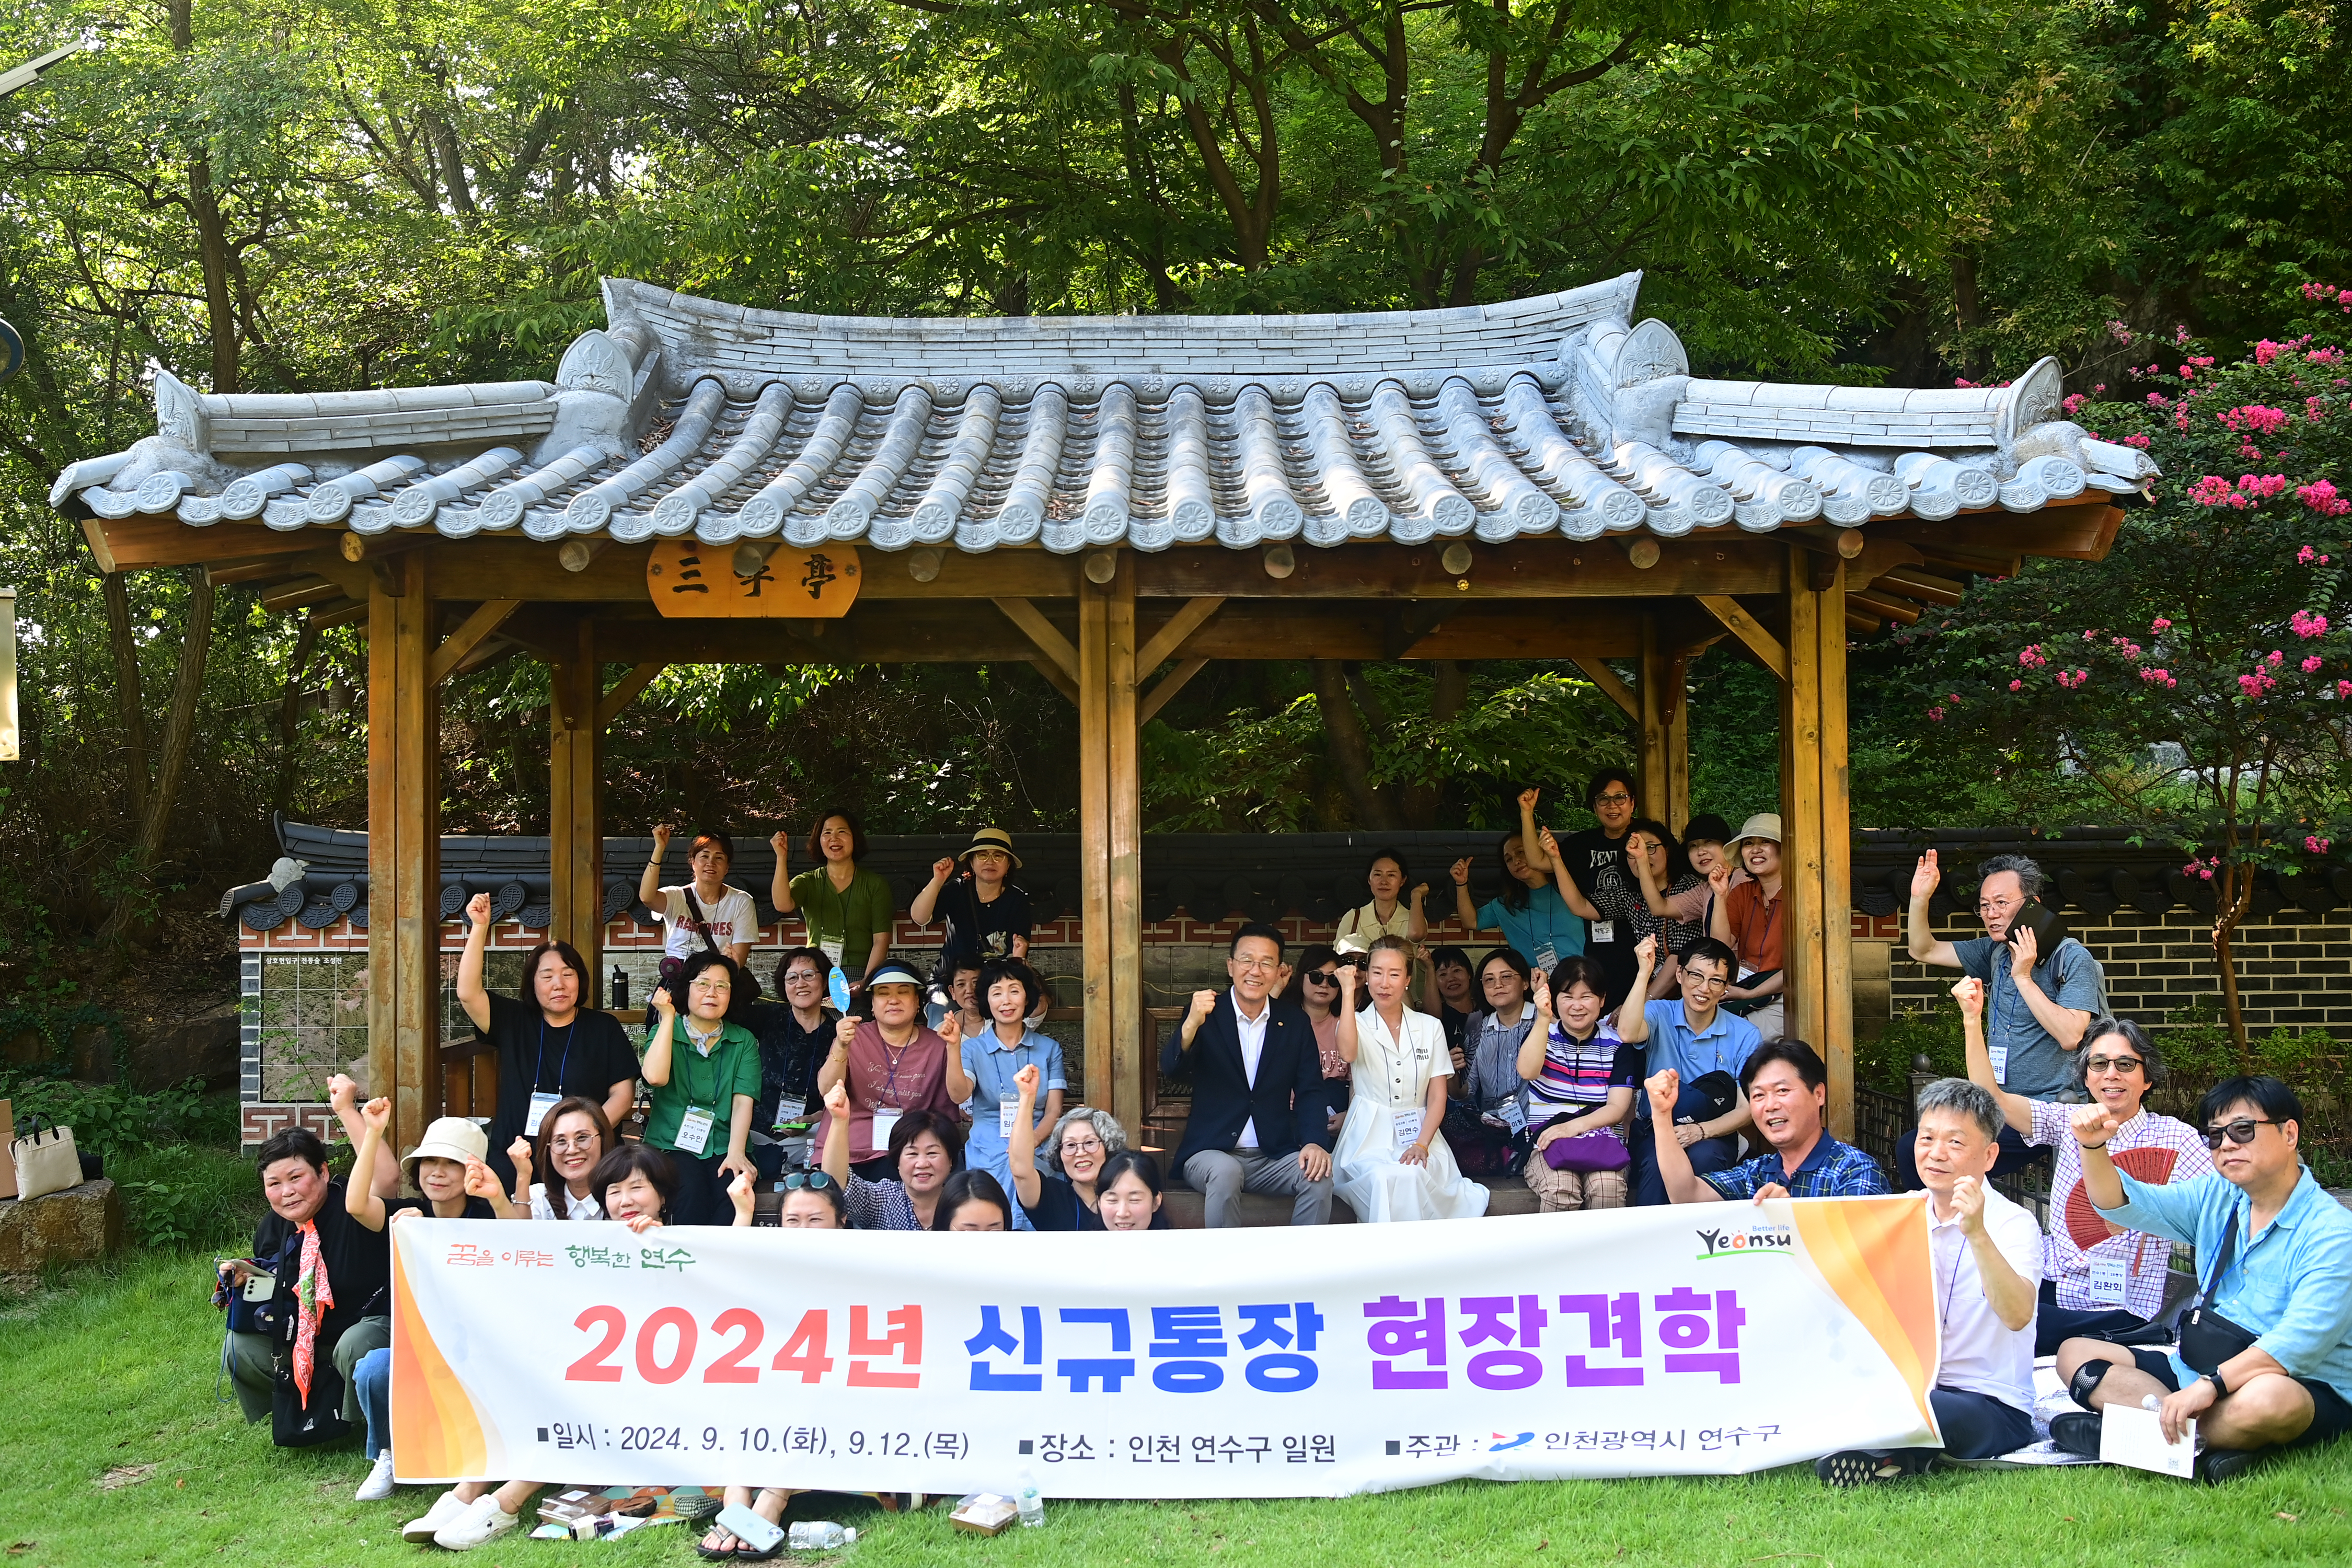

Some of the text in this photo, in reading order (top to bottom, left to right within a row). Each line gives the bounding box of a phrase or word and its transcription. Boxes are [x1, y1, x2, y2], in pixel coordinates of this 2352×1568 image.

[909, 1091, 922, 1100] you
[1398, 1126, 1419, 1137] 김연수
[1510, 1118, 1523, 1129] 미정
[681, 1132, 703, 1143] 오수인
[1696, 1228, 1791, 1255] Yeonsu
[447, 1243, 696, 1273] 꿈을 이루는 행복한 연수
[2093, 1281, 2122, 1292] 김환회
[565, 1287, 1746, 1393] 2024년 신규통장 현장견학
[553, 1422, 596, 1450] 일시
[621, 1426, 688, 1450] 2024.
[1040, 1433, 1096, 1463] 장소
[1129, 1435, 1180, 1463] 인천
[1192, 1435, 1272, 1463] 연수구
[1283, 1435, 1335, 1463] 일원
[1406, 1434, 1461, 1459] 주관
[1545, 1429, 1686, 1451] 인천광역시
[1699, 1424, 1781, 1450] 연수구
